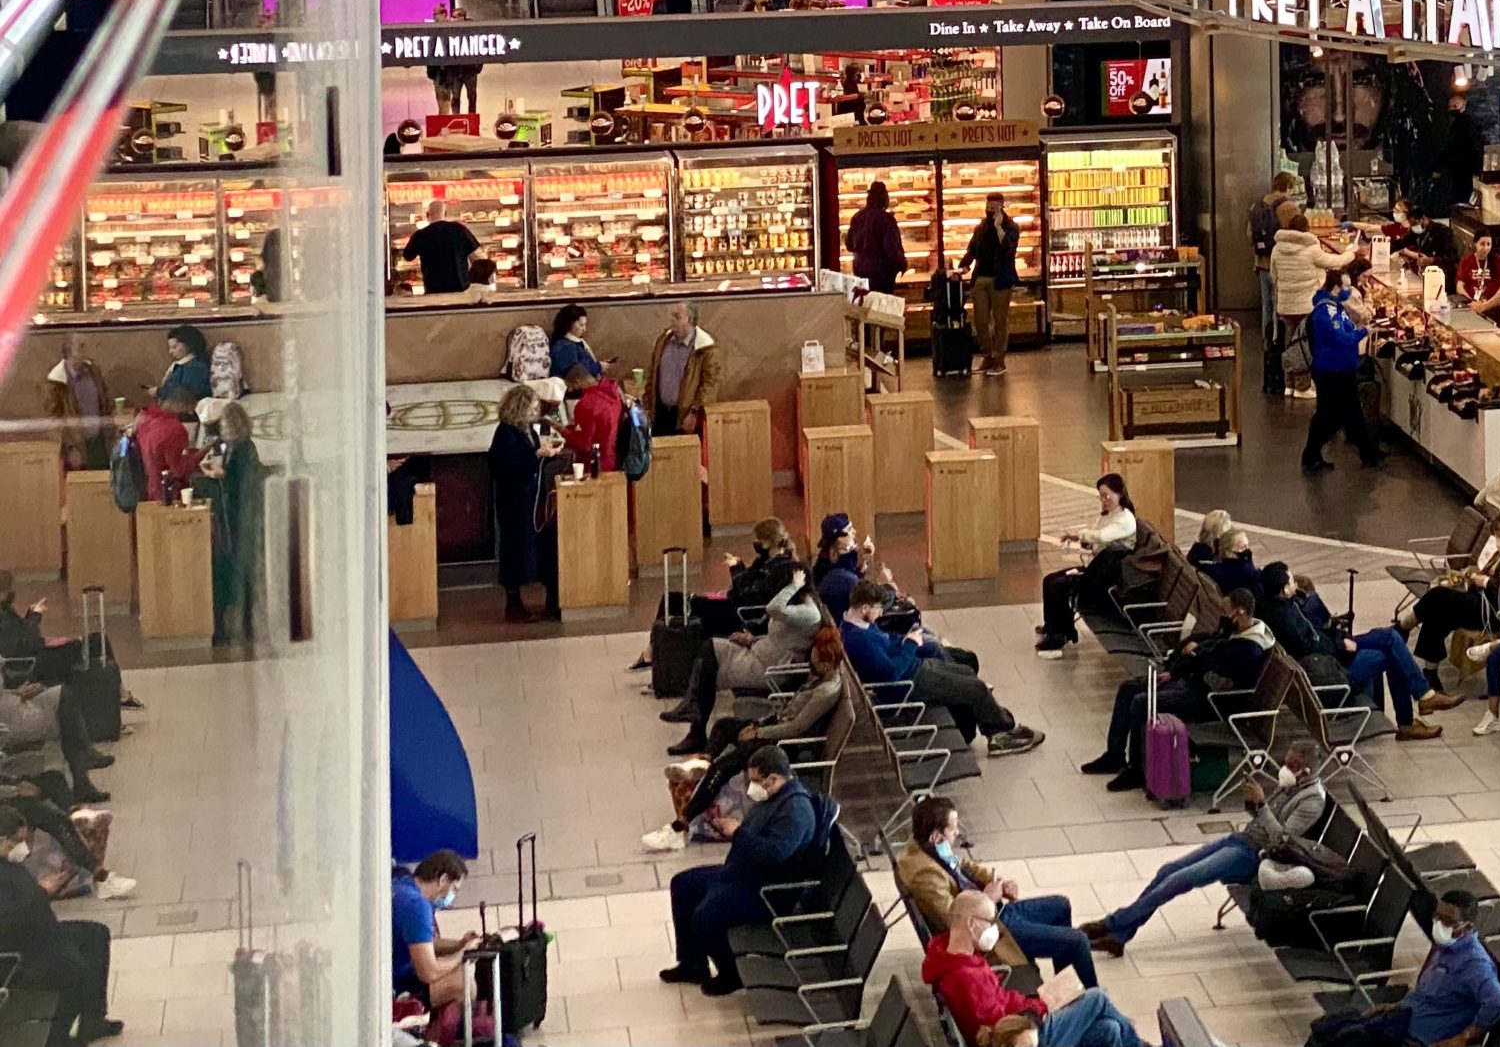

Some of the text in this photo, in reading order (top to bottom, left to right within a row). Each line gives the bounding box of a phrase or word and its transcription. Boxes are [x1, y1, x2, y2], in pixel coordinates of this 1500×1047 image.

[930, 15, 1171, 36] Dine In Take Away Take On Board
[394, 34, 506, 59] PRET A MANGER
[1109, 70, 1135, 86] 50%
[1109, 85, 1126, 97] Off
[757, 81, 821, 126] PRET
[857, 129, 913, 148] PRET'S HOT
[962, 124, 1017, 144] PRET'S HOT
